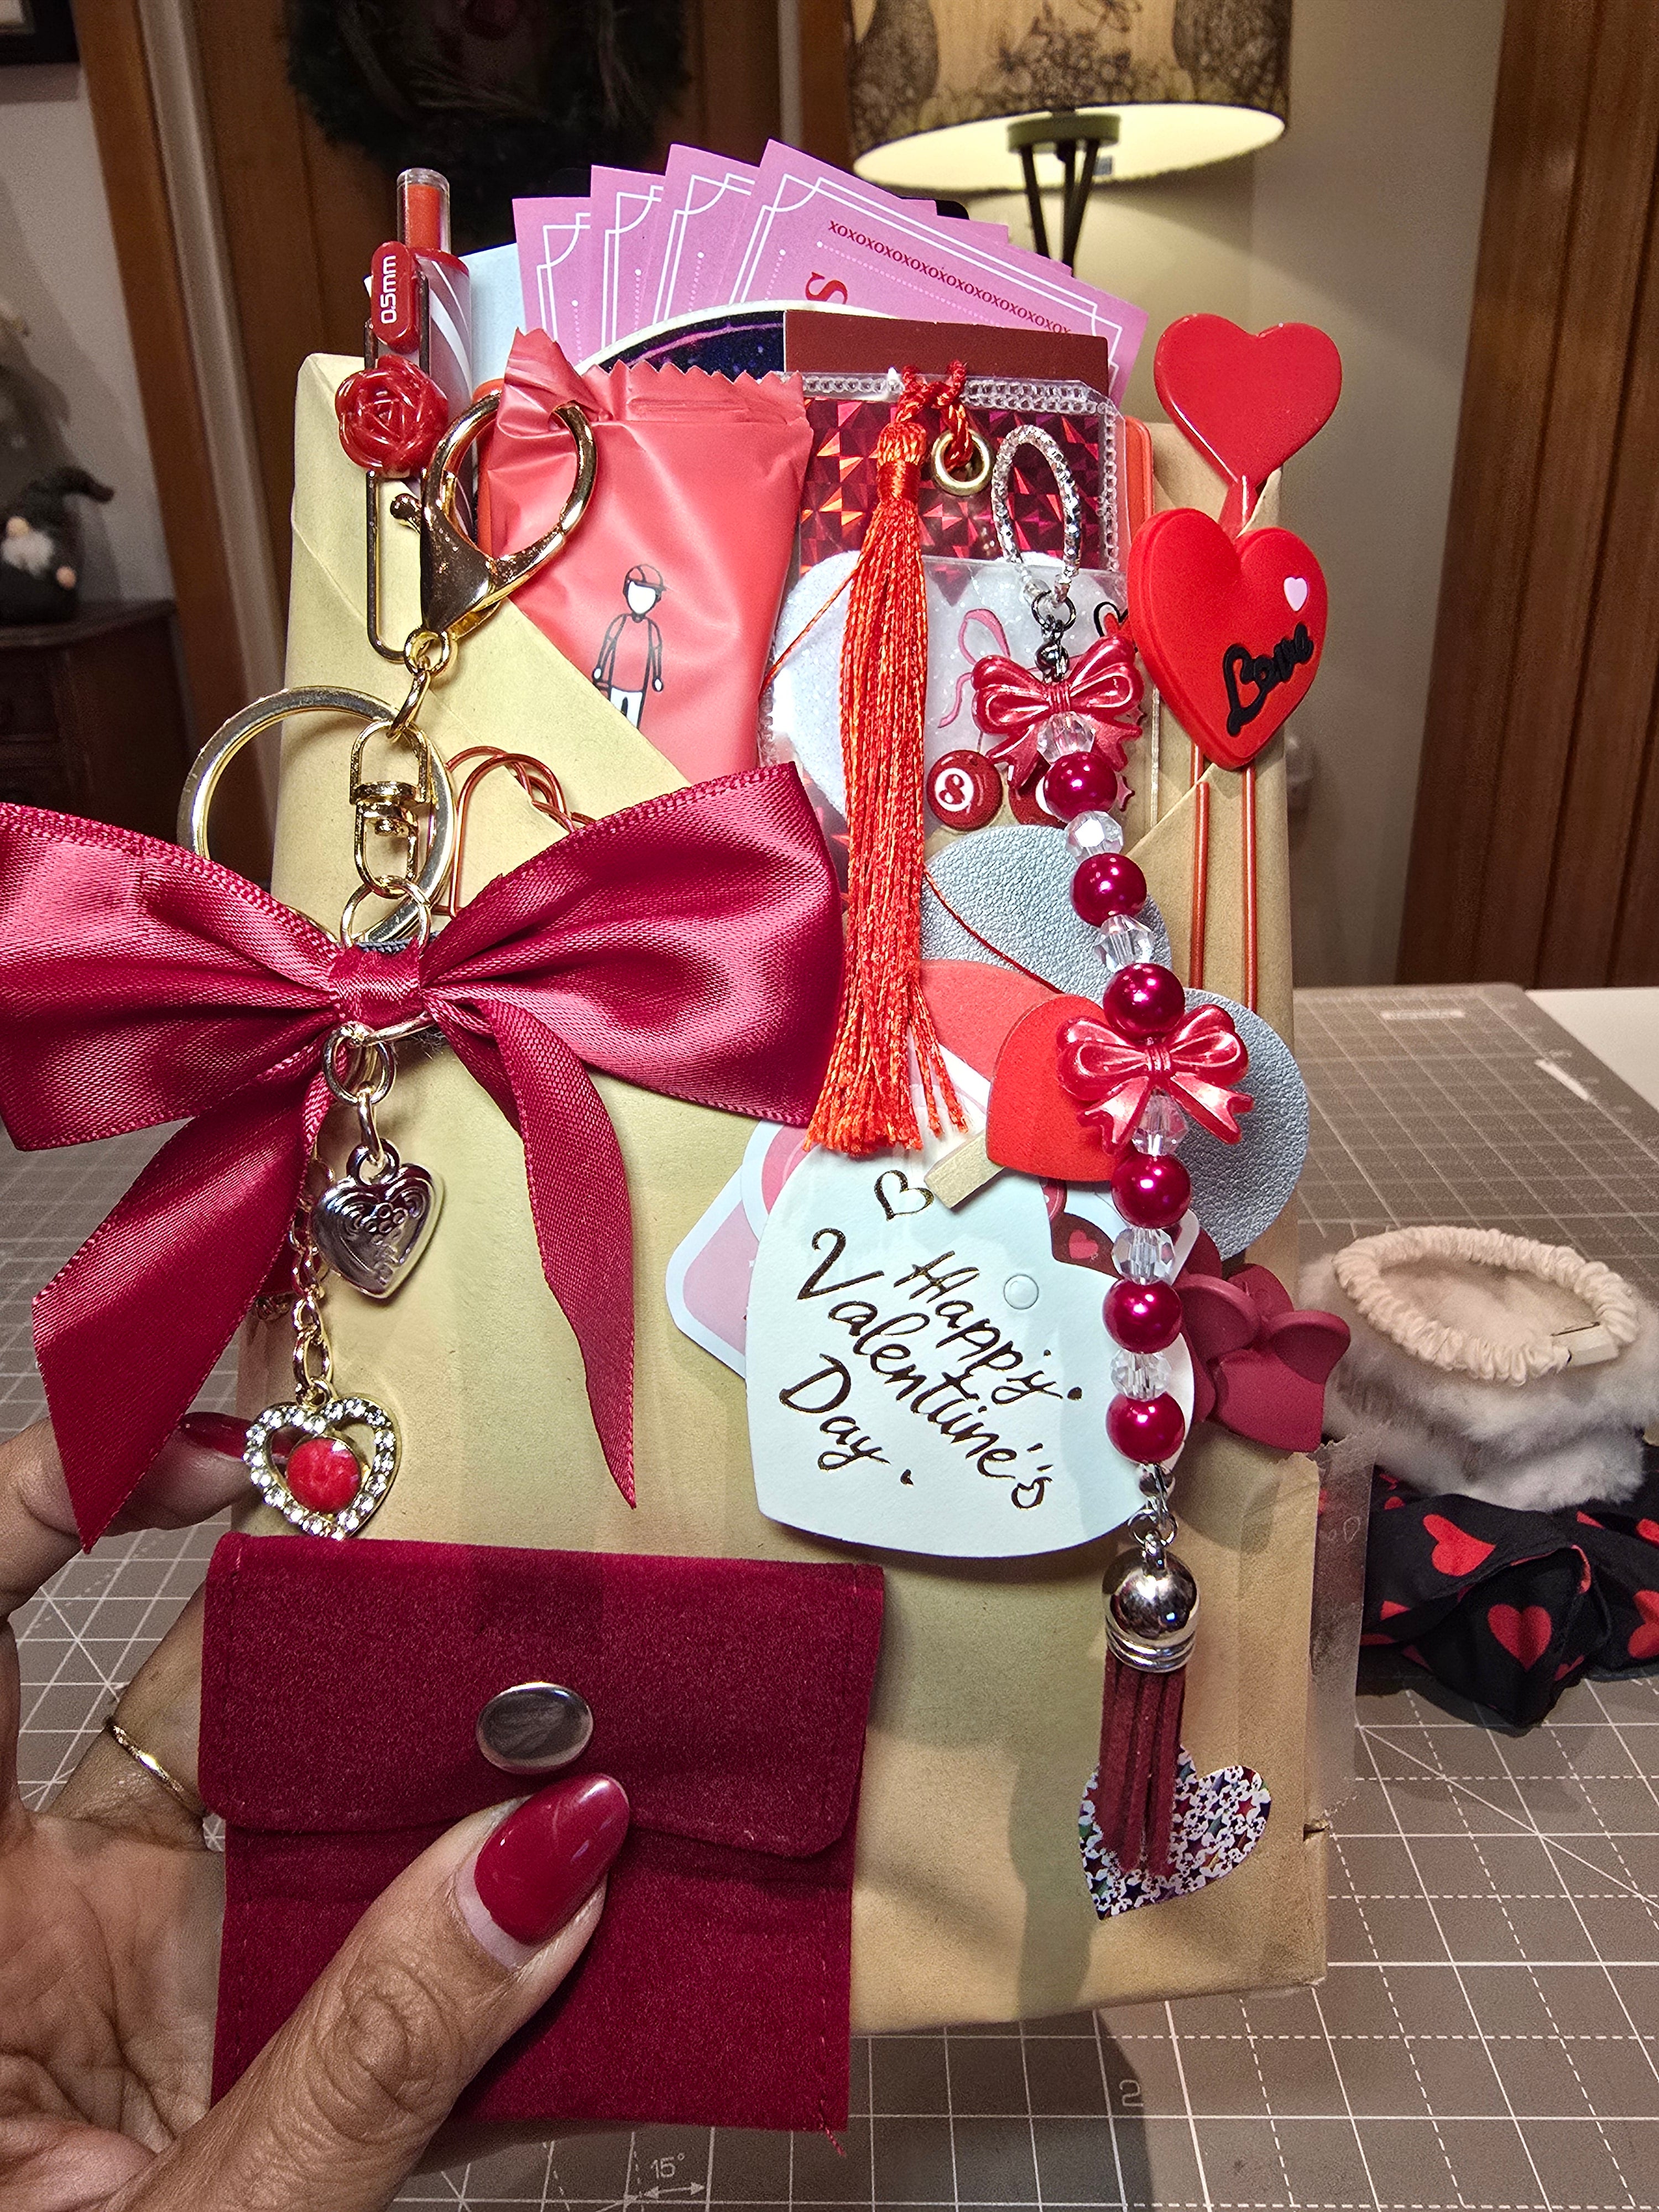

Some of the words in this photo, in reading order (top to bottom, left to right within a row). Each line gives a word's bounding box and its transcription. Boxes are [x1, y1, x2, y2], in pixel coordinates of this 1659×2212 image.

[380, 255, 397, 324] 0.5mm
[1223, 622, 1314, 736] Love
[797, 1227, 1053, 1510] Valentine's
[1119, 2079, 1143, 2107] 2
[650, 2152, 685, 2178] 15°
